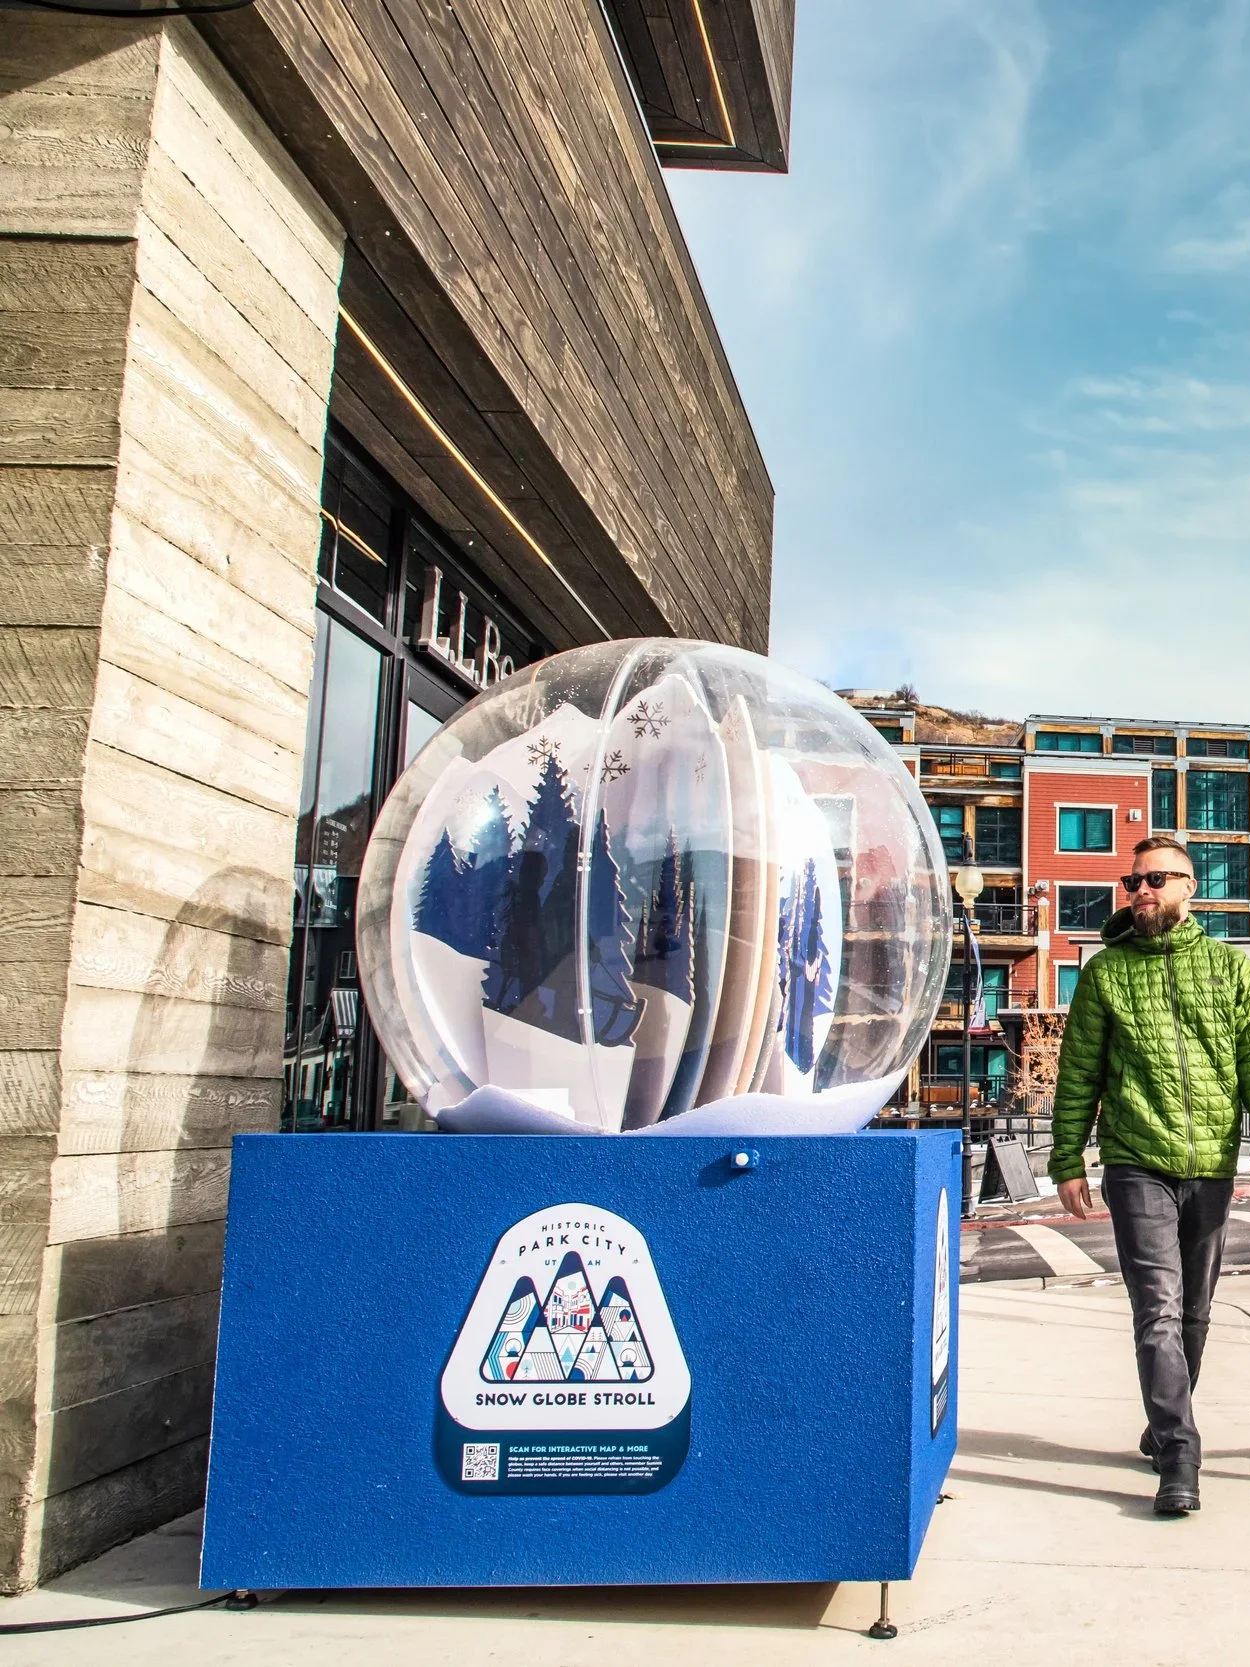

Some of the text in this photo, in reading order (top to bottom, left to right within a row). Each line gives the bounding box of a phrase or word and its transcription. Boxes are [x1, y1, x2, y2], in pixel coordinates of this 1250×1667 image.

[418, 565, 515, 691] L.L.Be
[541, 1221, 606, 1233] HISTORIC
[518, 1234, 626, 1257] PARK CITY
[475, 1392, 656, 1406] SNOW GLOBE STROLL
[509, 1445, 649, 1453] SCAN FOR INTERACTIVE MAP & MORE
